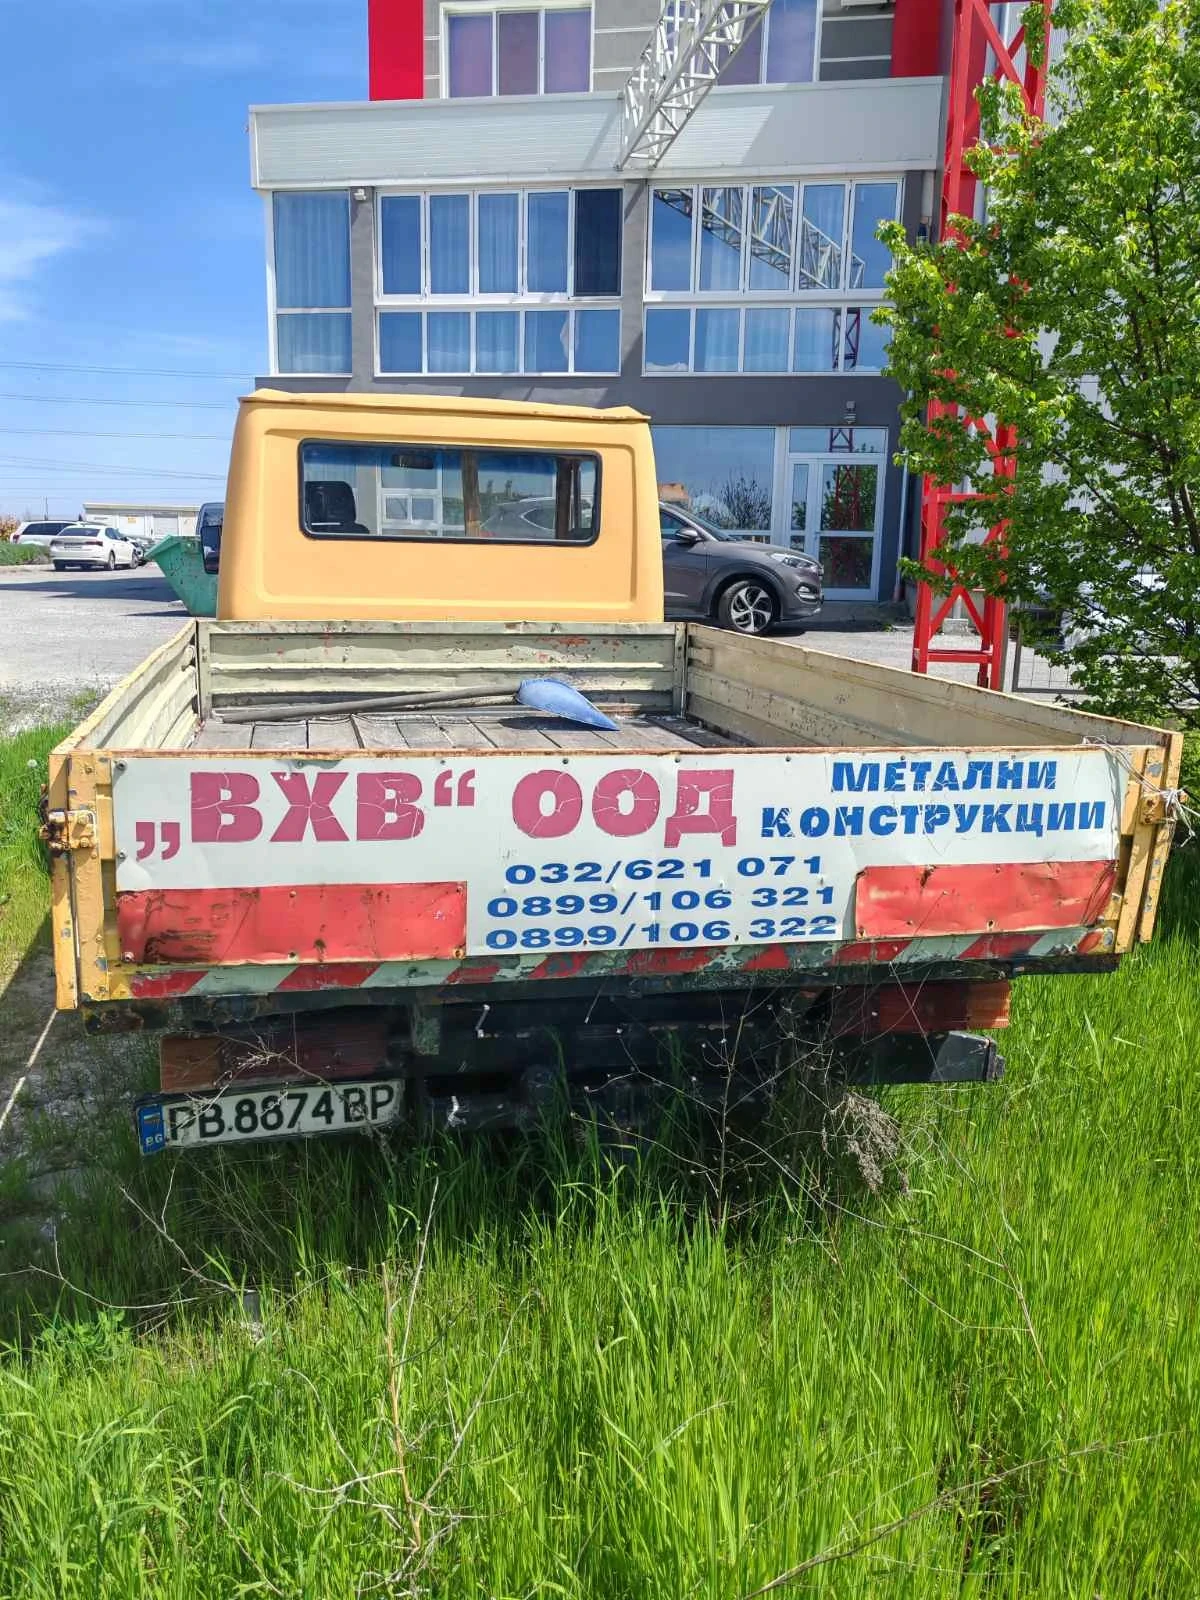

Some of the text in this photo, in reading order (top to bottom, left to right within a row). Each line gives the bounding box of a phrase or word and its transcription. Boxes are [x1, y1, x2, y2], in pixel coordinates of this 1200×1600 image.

[831, 760, 1057, 792] МЕТАЛНИ
[512, 768, 737, 848] ООД
[760, 800, 1106, 837] КОНСТРУКЦИИ
[505, 856, 823, 884] 032/621 071
[487, 886, 835, 917] 0899/106 321
[485, 916, 838, 949] 0899/106 322
